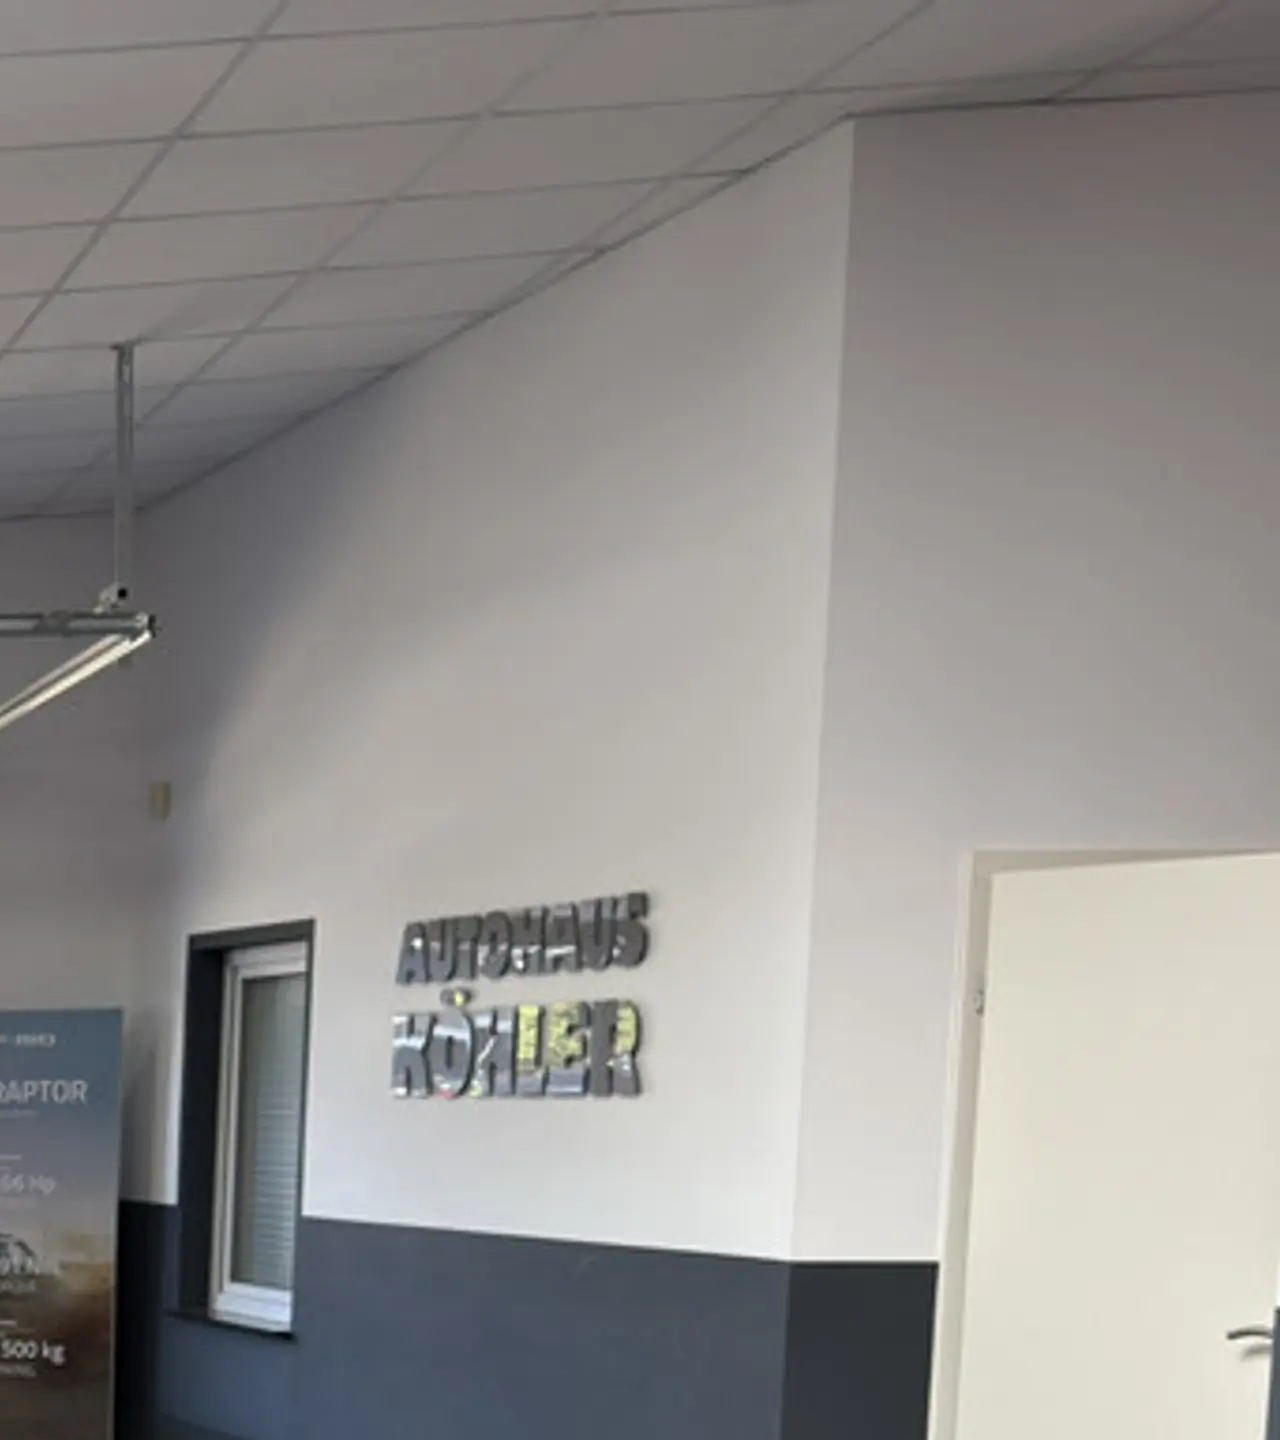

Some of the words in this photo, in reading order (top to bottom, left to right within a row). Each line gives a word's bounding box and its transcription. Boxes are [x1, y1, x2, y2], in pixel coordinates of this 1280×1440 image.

[395, 891, 651, 985] AUTOHAUS
[392, 986, 643, 1099] KÖHLER
[41, 1338, 67, 1367] kg
